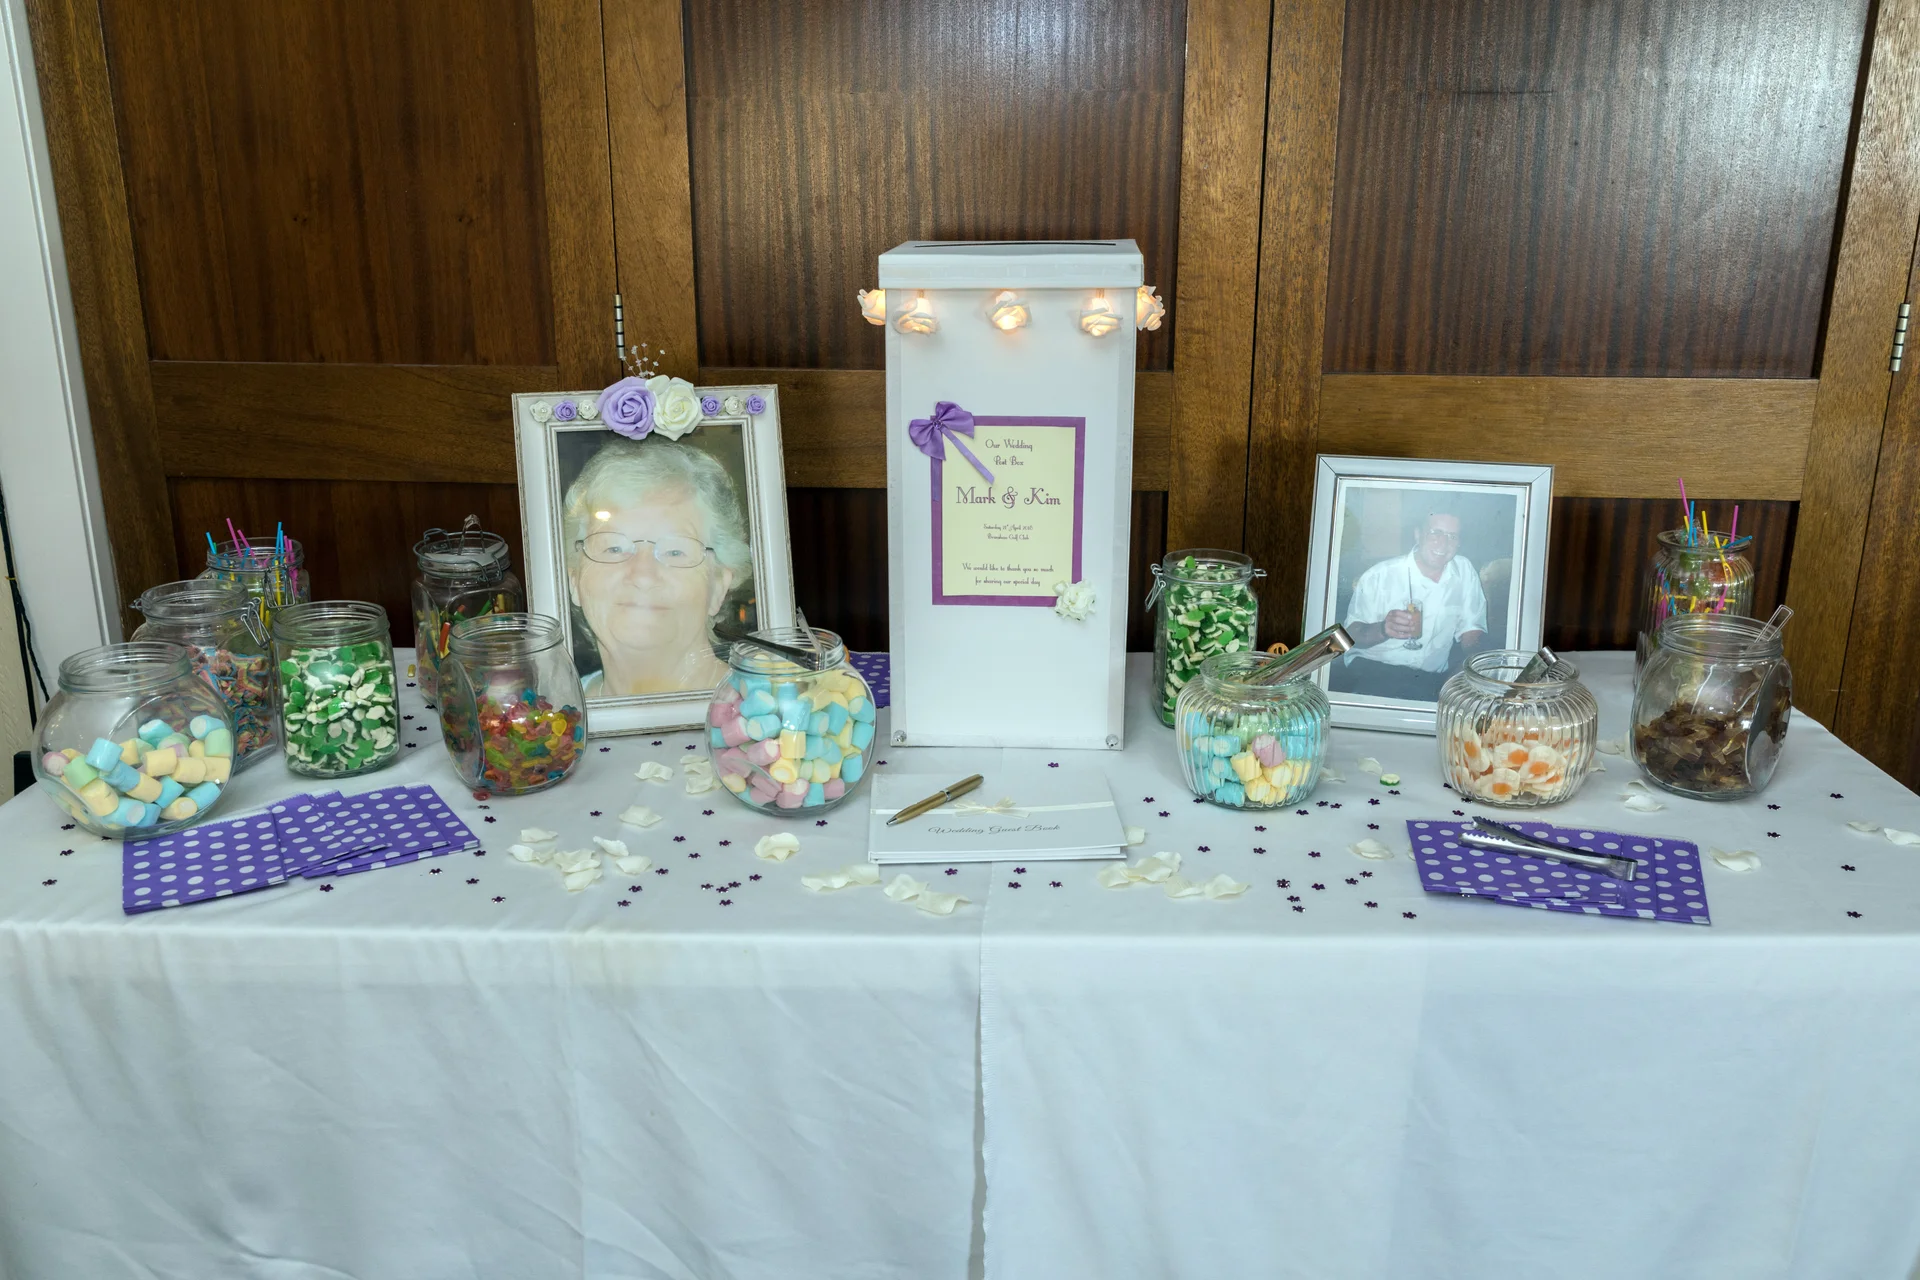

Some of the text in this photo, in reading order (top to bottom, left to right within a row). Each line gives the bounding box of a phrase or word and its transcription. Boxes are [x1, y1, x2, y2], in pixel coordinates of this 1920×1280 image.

[985, 438, 1033, 452] Our Wedding
[993, 455, 1025, 466] Post Box
[956, 486, 1061, 509] Mark & Kim
[962, 562, 972, 571] We
[1007, 564, 1022, 572] thank
[1040, 565, 1054, 573] much
[983, 576, 1002, 586] sharing
[1012, 578, 1030, 587] special
[1030, 577, 1041, 587] day
[928, 824, 1060, 835] Wedding Guest Book
